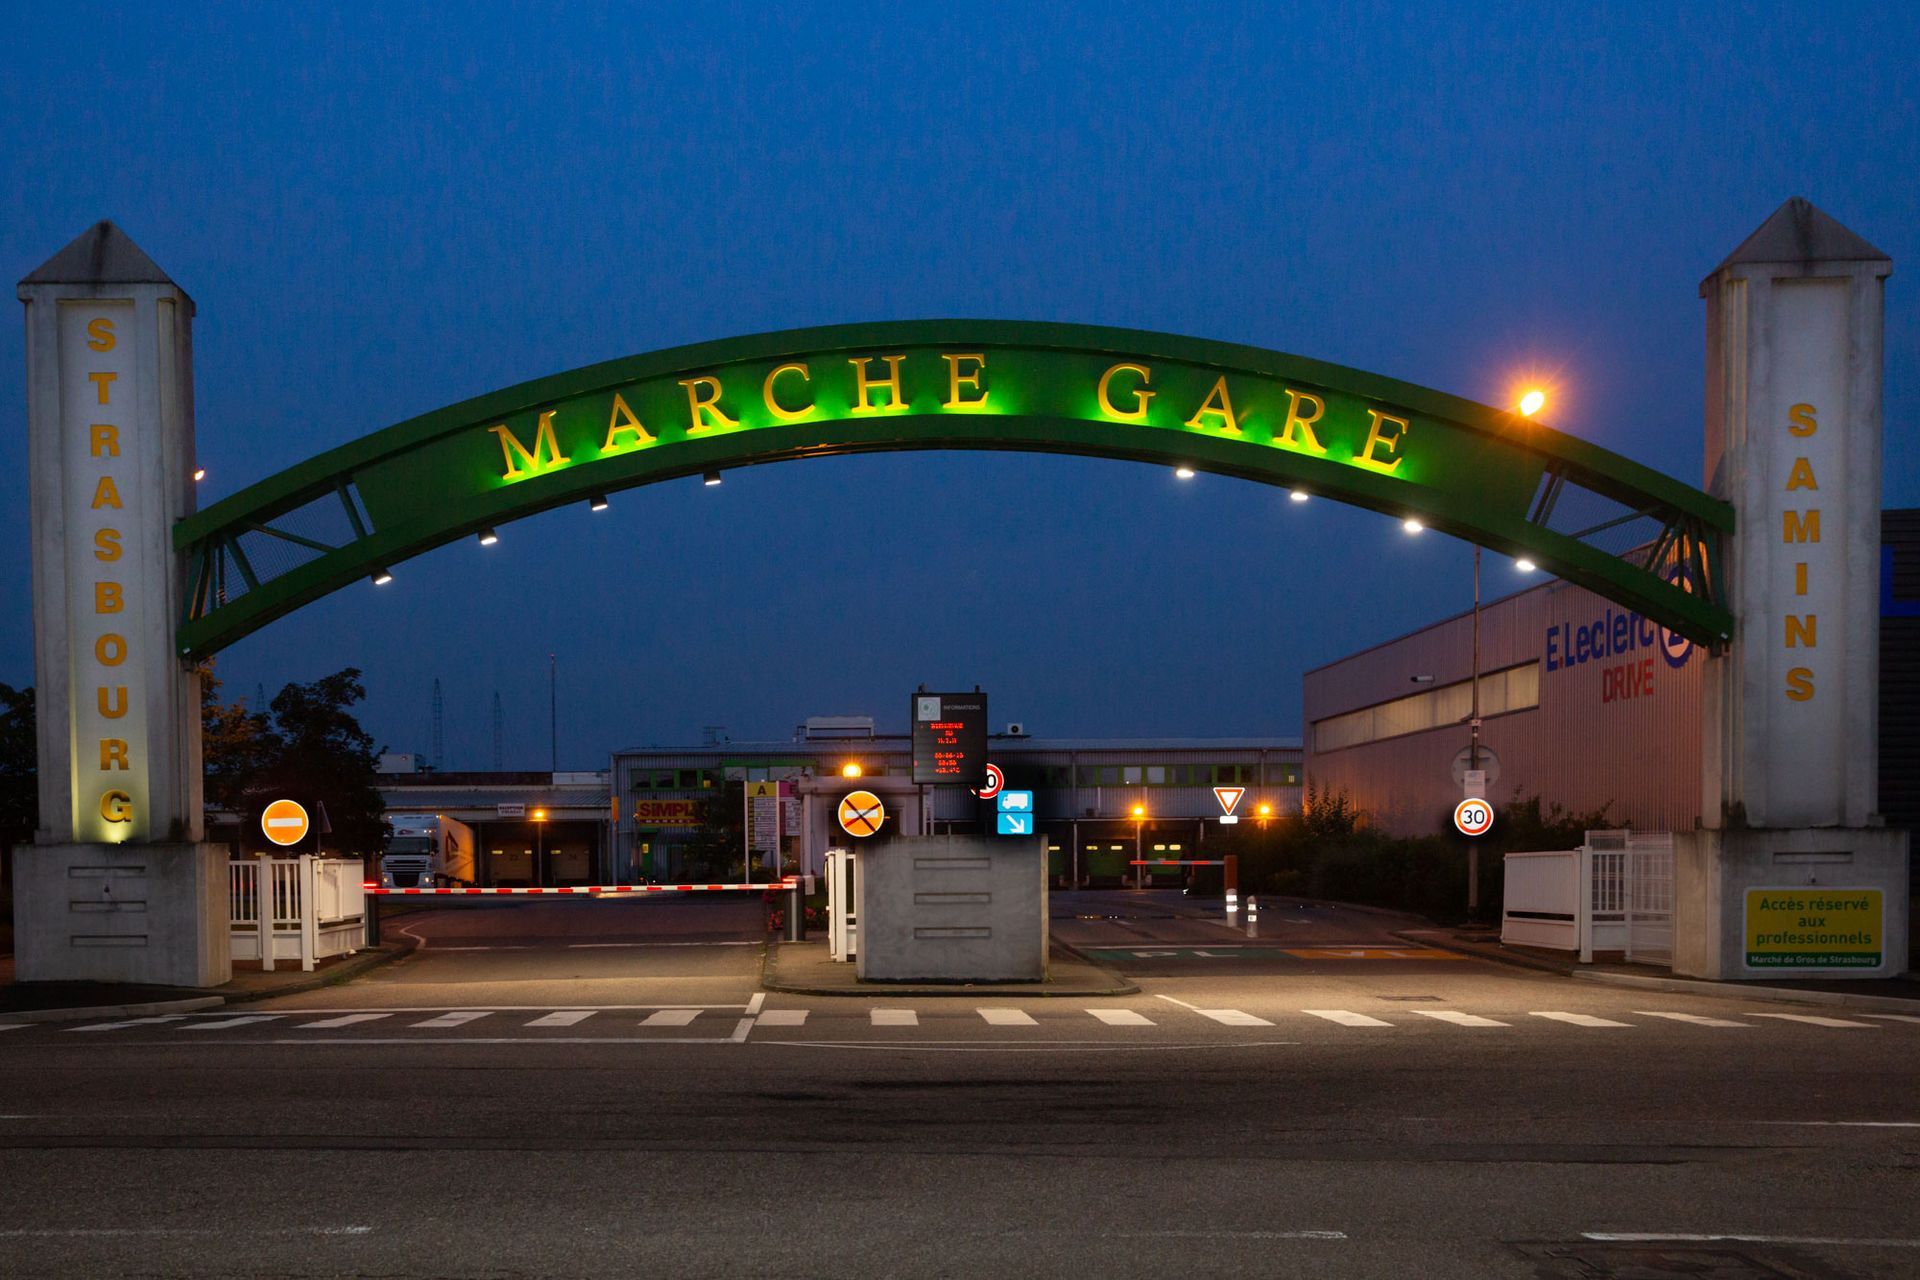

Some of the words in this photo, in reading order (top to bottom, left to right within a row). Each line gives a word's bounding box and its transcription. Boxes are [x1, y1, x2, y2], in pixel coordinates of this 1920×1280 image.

[488, 353, 989, 481] MARCHE
[1097, 362, 1410, 473] GARE
[1783, 403, 1820, 702] SAMINS
[87, 317, 133, 824] STRASBOURG
[1546, 608, 1655, 672] E.Leclerc
[1602, 658, 1655, 703] DRIVE
[757, 785, 767, 796] A
[1463, 809, 1485, 825] 30
[1759, 896, 1805, 911] Accès
[1808, 896, 1869, 911] réservé
[1797, 916, 1826, 928] aux
[1756, 931, 1873, 947] professionnels
[1751, 955, 1782, 964] Marché
[1783, 955, 1795, 964] de
[1795, 955, 1816, 964] Gros
[1817, 955, 1828, 964] de
[1829, 955, 1877, 965] Strasbourg
